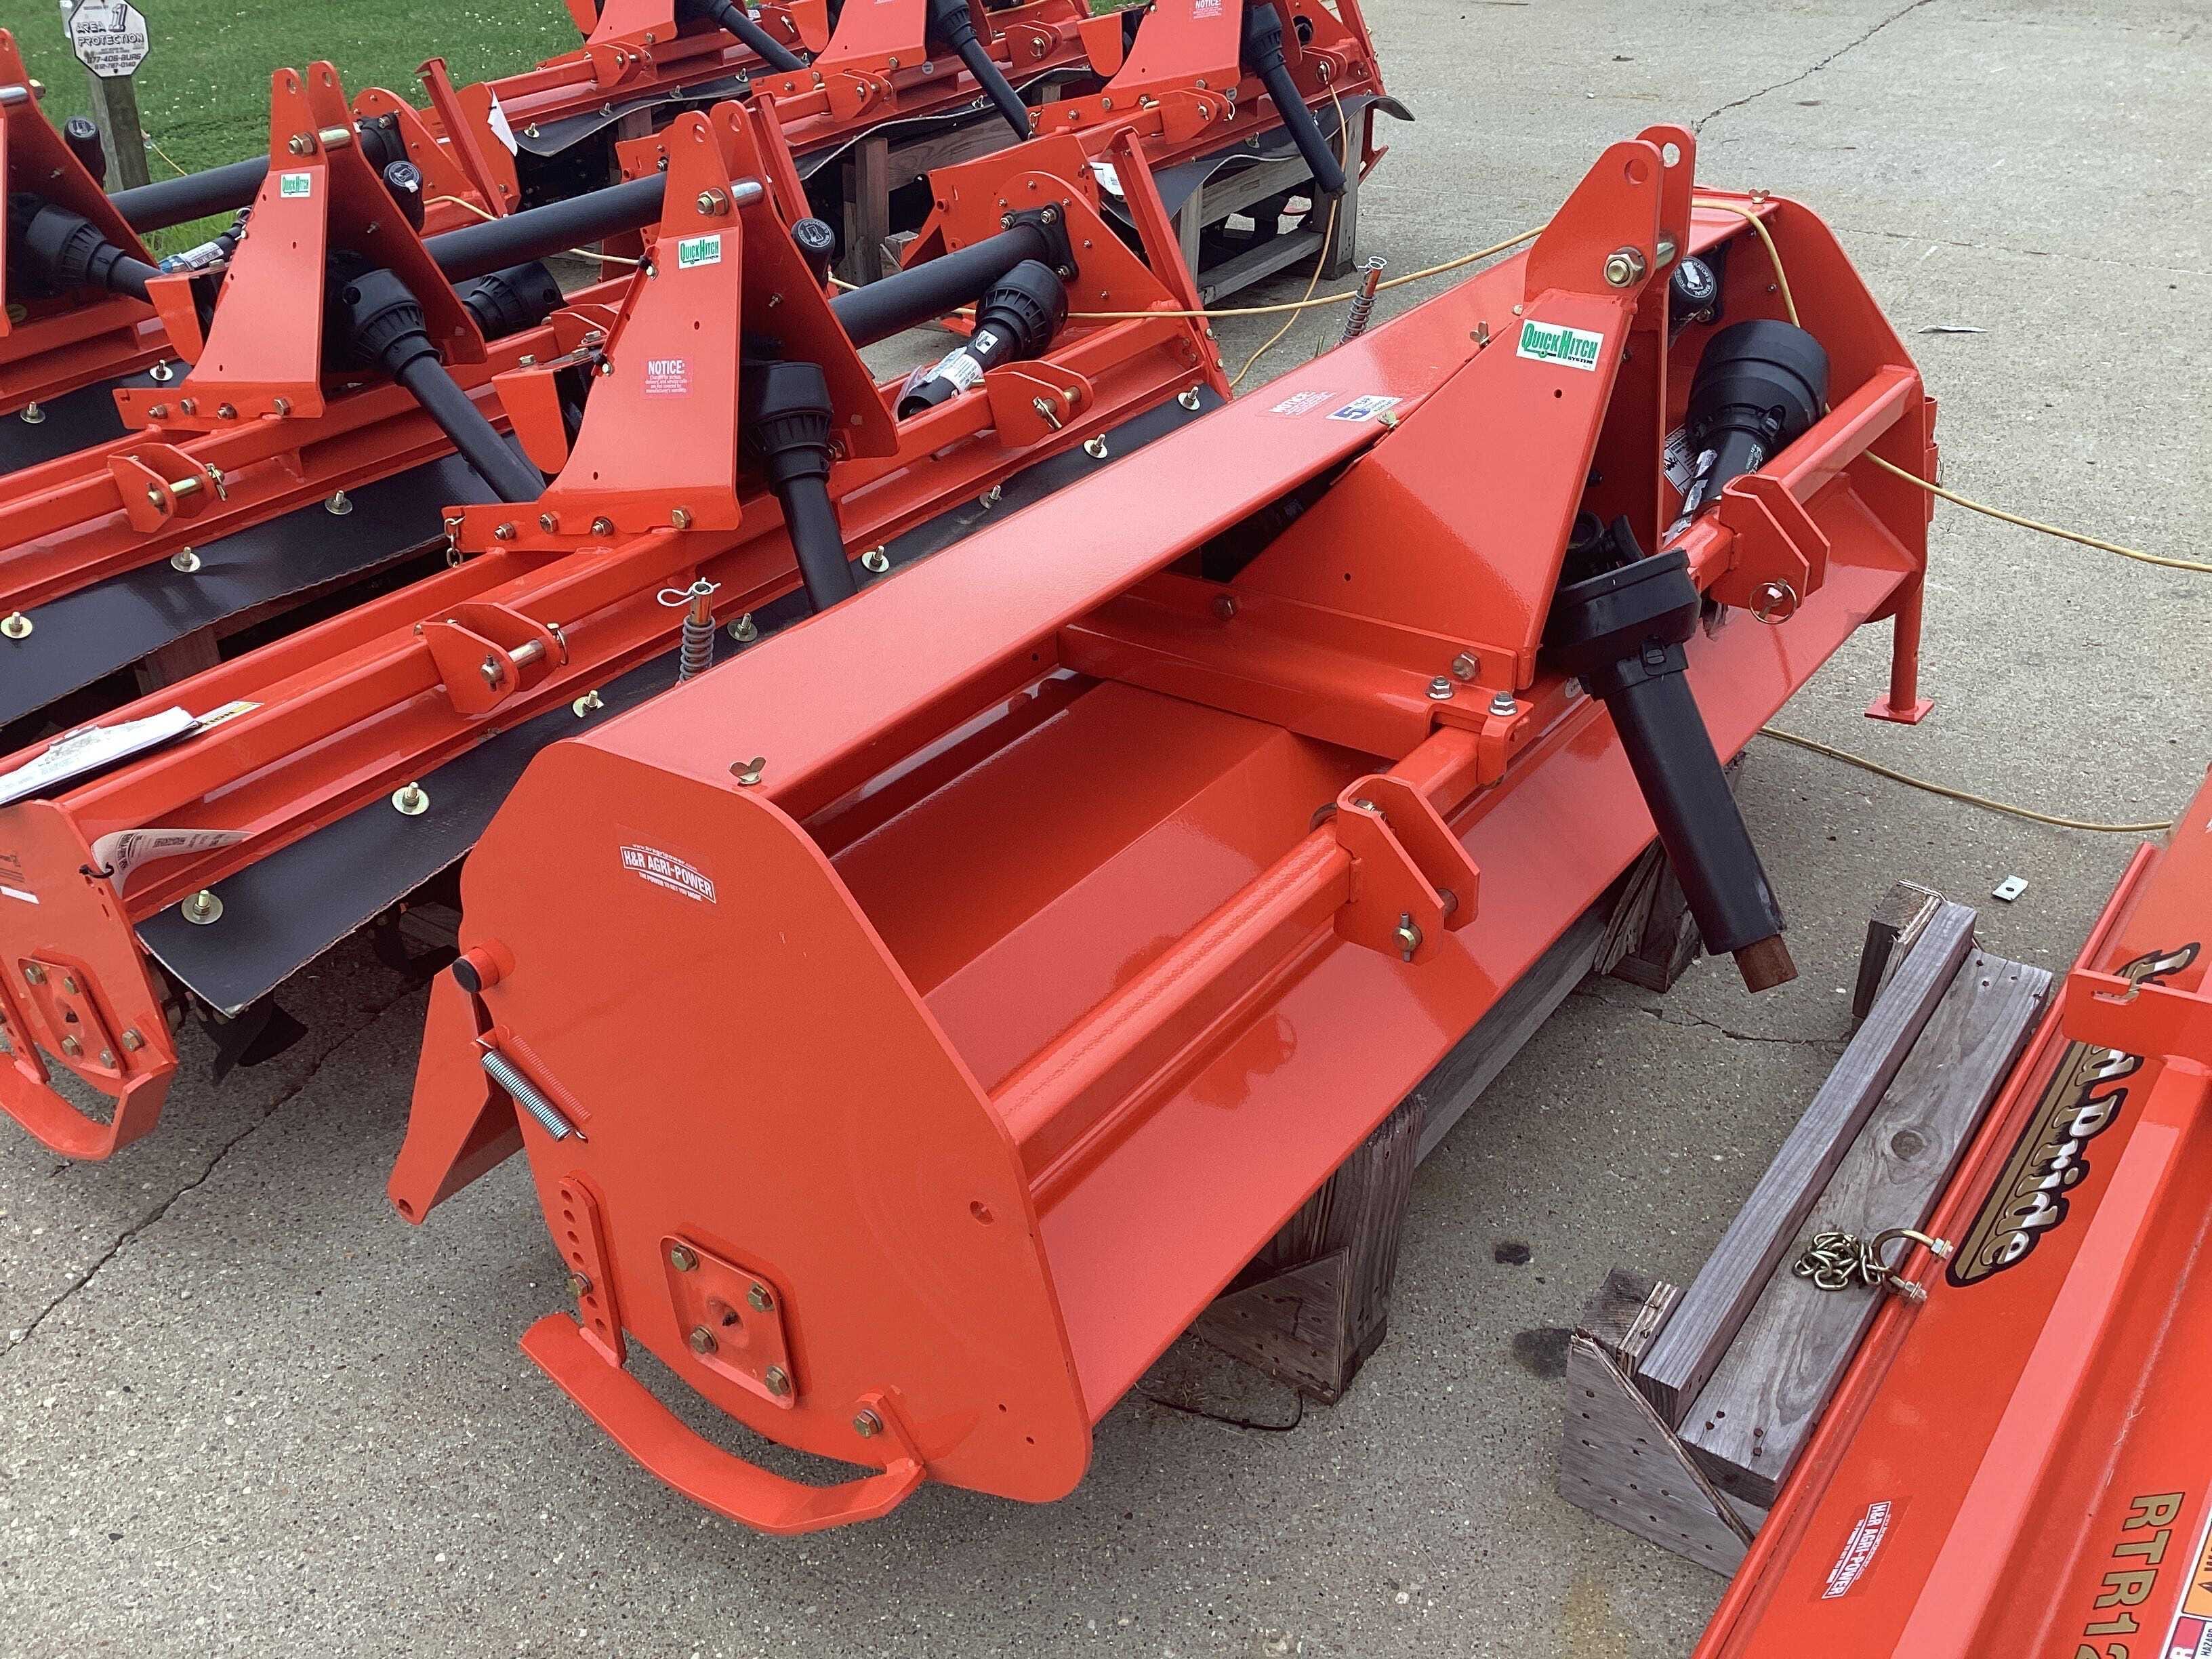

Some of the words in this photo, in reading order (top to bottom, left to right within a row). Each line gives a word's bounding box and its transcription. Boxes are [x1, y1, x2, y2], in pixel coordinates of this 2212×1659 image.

[77, 21, 106, 33] AREA
[108, 3, 127, 33] 1
[78, 33, 144, 47] PROTECTION
[649, 359, 685, 375] NOTICE:
[1568, 356, 1593, 365] SYSTEM
[623, 851, 646, 867] H&R
[647, 855, 712, 897] AGRI-POWER
[1980, 1094, 2119, 1267] Pride
[1866, 1504, 1887, 1527] H&R
[1827, 1528, 1879, 1595] AGRI-POWER
